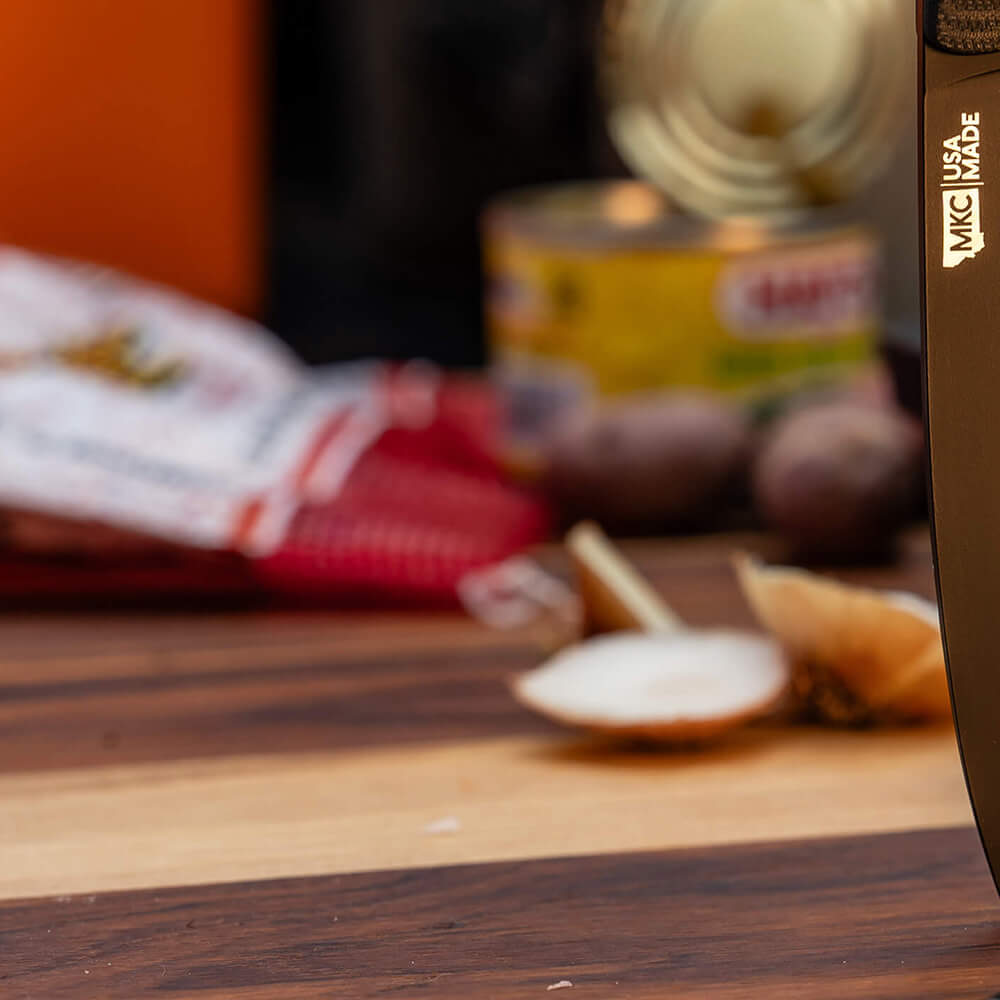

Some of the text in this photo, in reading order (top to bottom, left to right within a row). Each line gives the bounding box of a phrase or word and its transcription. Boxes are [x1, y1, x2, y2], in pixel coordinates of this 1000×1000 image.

[943, 134, 962, 181] USA
[961, 112, 980, 180] MADE
[949, 195, 973, 252] MKC
